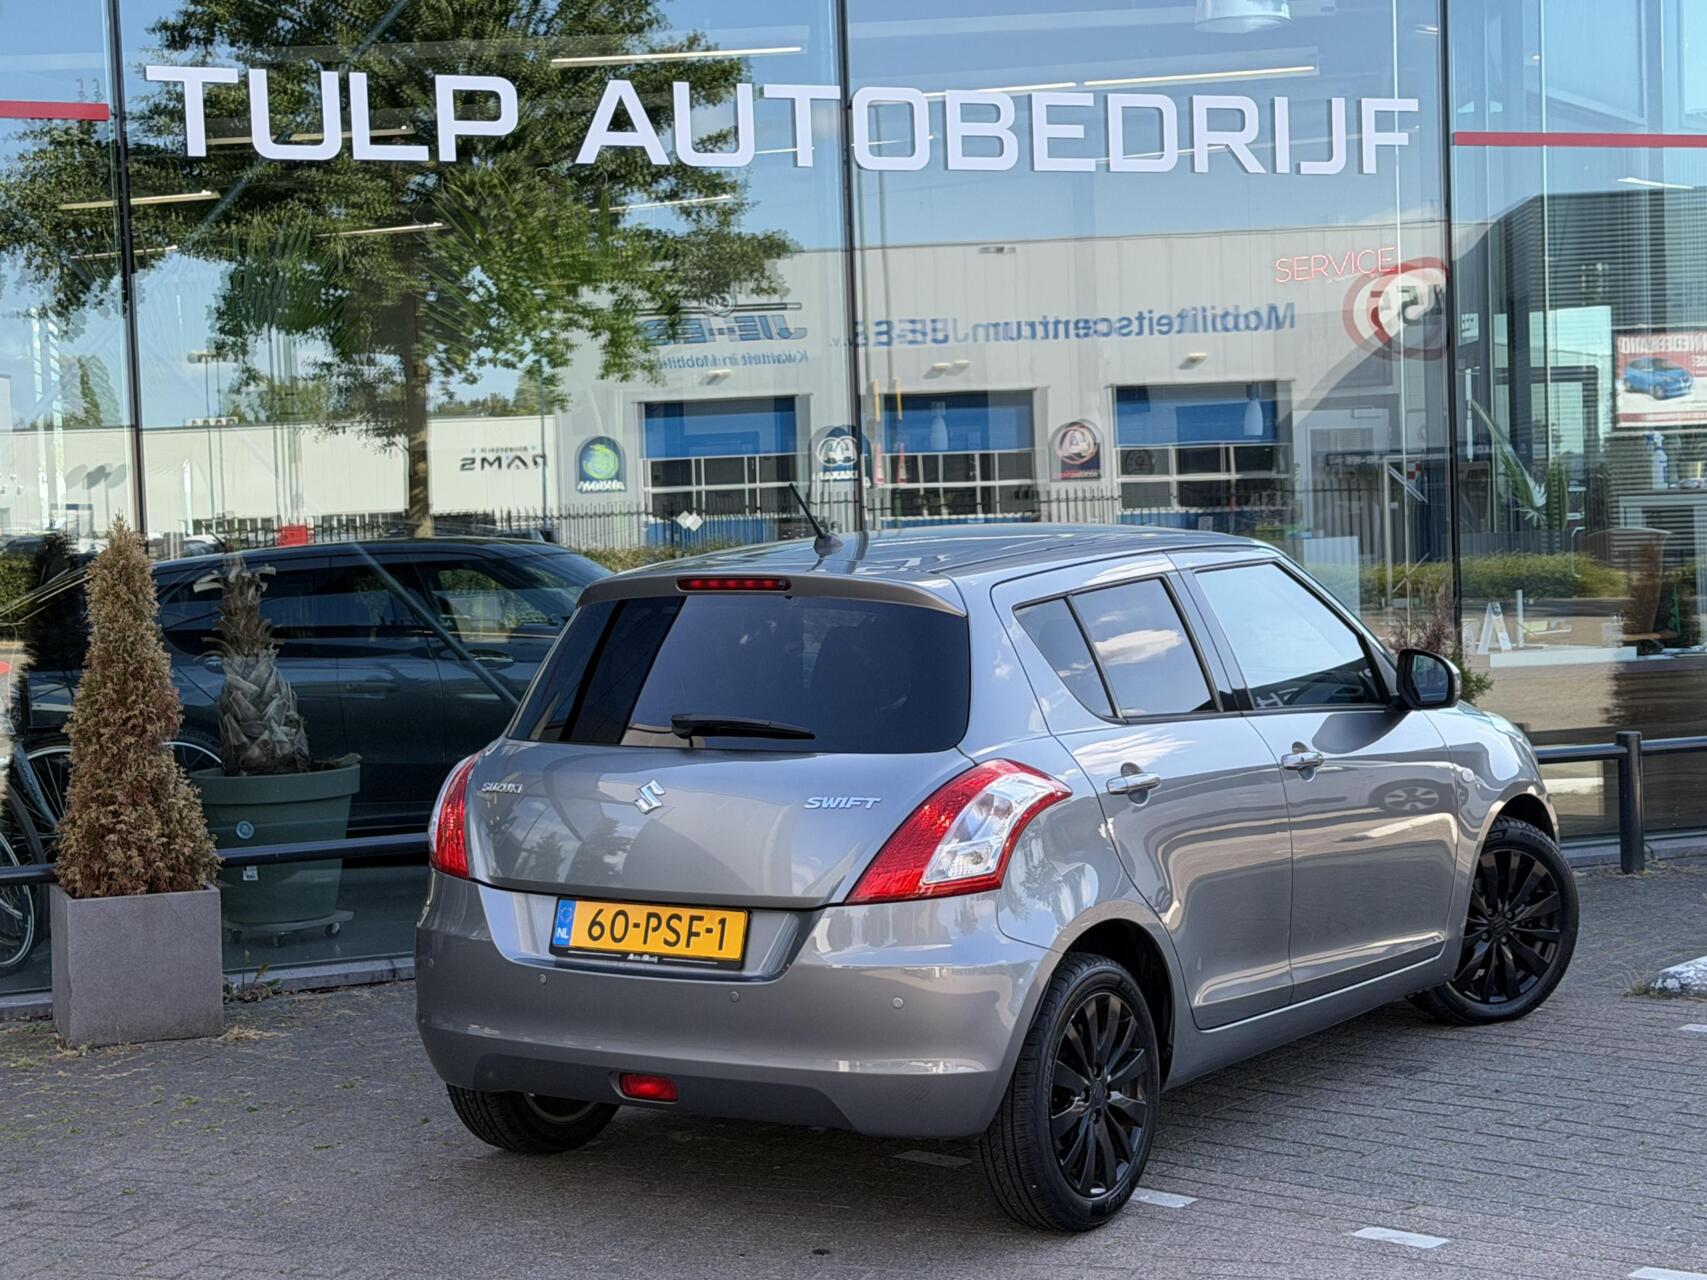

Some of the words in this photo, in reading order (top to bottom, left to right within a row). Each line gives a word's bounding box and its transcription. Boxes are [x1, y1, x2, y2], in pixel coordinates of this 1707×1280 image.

[146, 65, 518, 163] TULP
[576, 80, 1419, 175] AUTOBEDRIJF
[1275, 247, 1395, 283] SERVICE
[481, 782, 523, 793] SUZUKI
[804, 797, 881, 809] SWIFT
[556, 928, 569, 938] NL
[587, 909, 728, 951] 60-PSF-1
